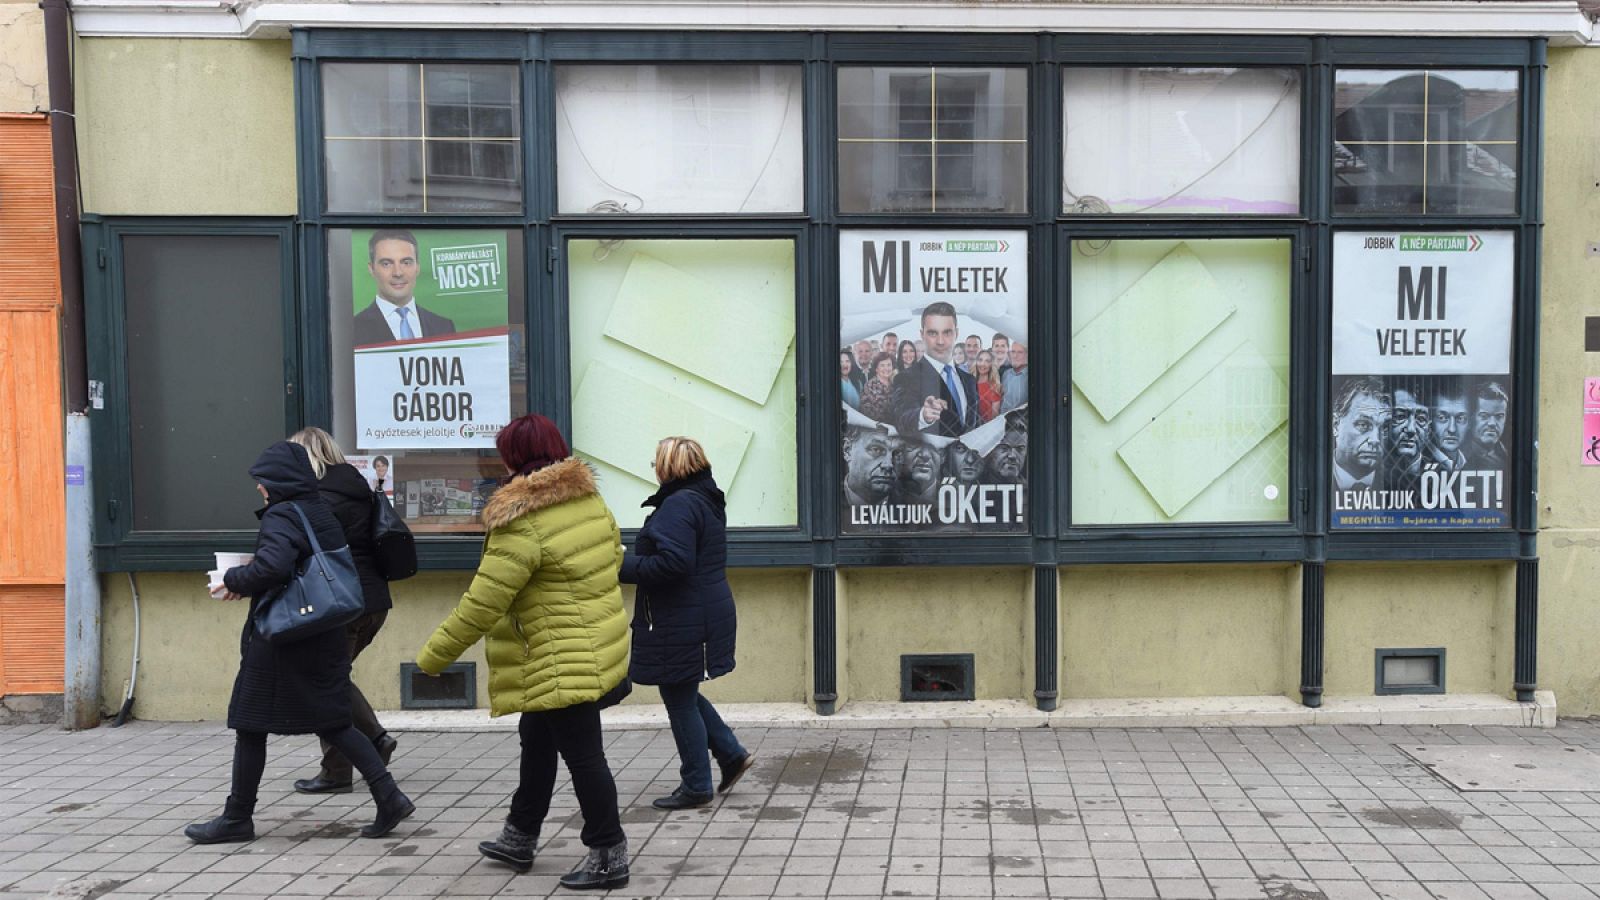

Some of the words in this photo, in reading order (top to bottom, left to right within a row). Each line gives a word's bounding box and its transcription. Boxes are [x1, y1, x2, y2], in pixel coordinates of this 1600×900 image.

[920, 242, 943, 251] JOBBIK
[1364, 237, 1395, 249] JOBBIK
[1402, 238, 1408, 249] A
[1411, 237, 1425, 249] NÉP
[1427, 236, 1465, 250] PÁRTJÁN!
[437, 262, 497, 289] MOST!
[862, 240, 911, 293] MI
[920, 267, 1008, 292] VELETEK
[1397, 266, 1447, 320] MI
[1377, 328, 1466, 355] VELETEK
[399, 356, 464, 386] VONA
[393, 387, 473, 421] GÁBOR
[366, 428, 372, 437] A
[1335, 487, 1415, 510] LEVÁLTJUK
[1420, 463, 1503, 509] ŐKET!
[851, 503, 932, 524] LEVÁLTJUK
[938, 477, 1024, 524] ŐKET!
[1340, 516, 1394, 525] MEGNYÍLT!!
[1450, 516, 1474, 526] kapu
[1477, 516, 1501, 525] alatt
